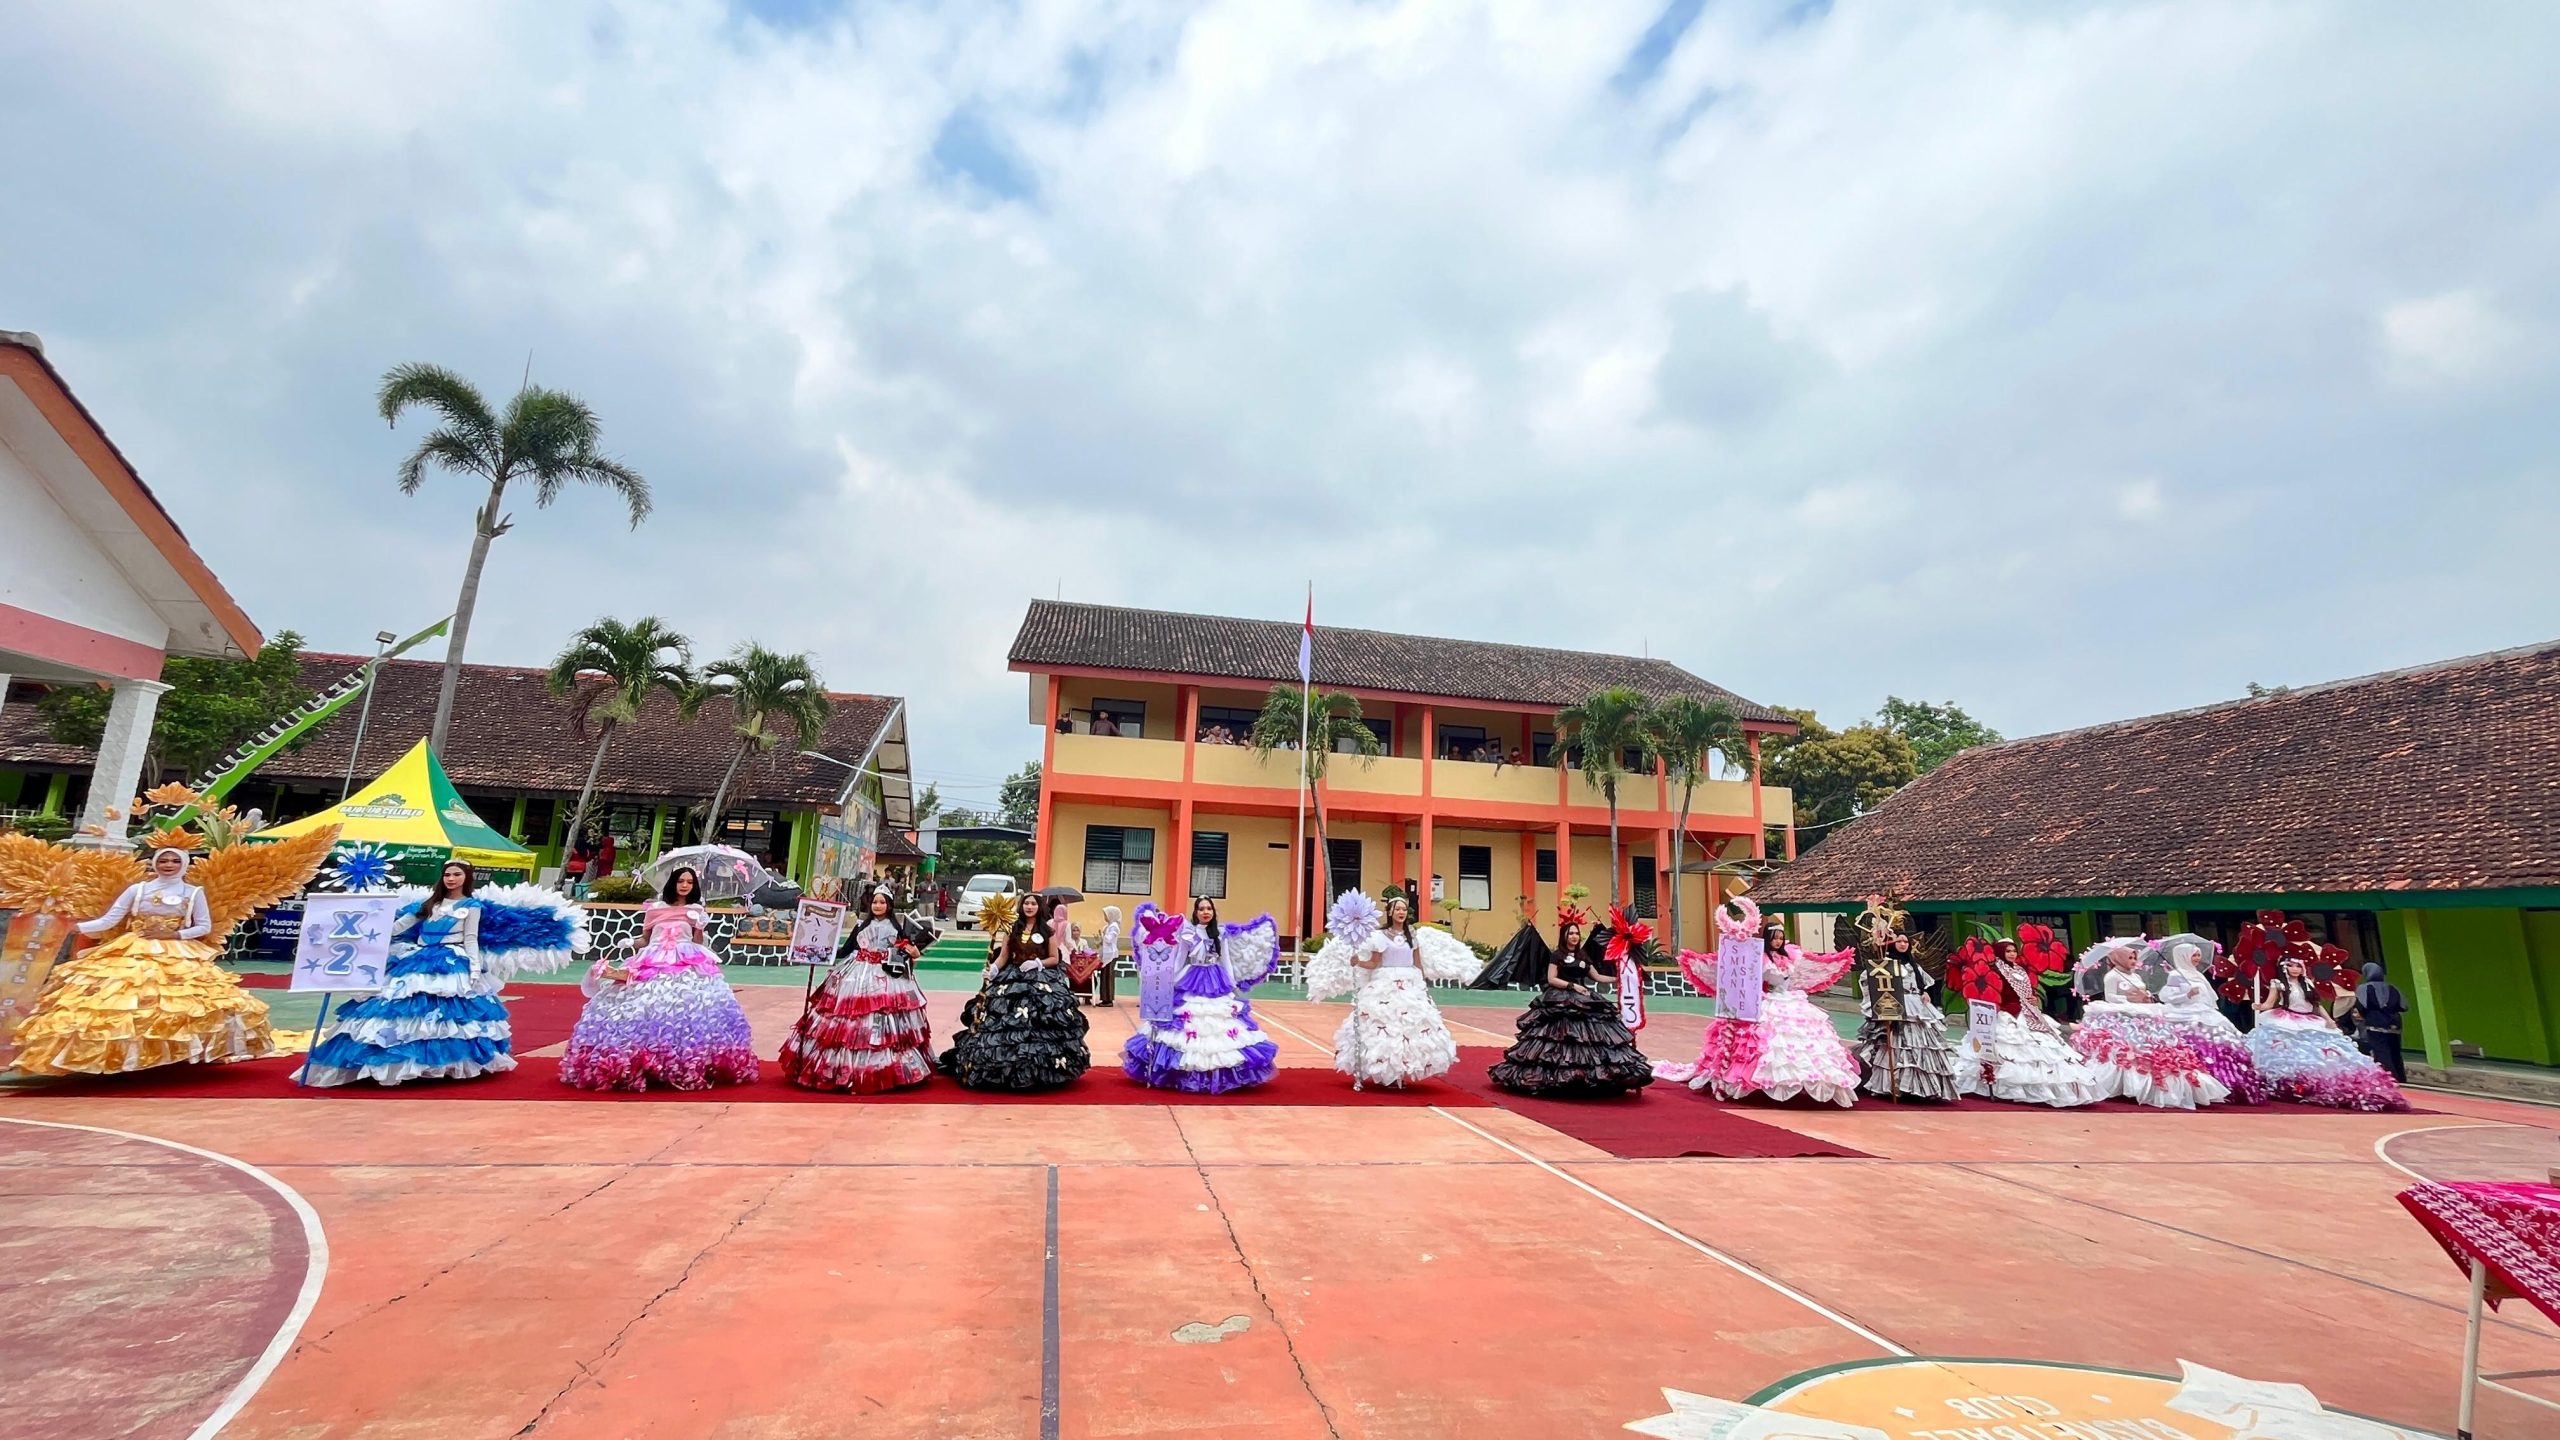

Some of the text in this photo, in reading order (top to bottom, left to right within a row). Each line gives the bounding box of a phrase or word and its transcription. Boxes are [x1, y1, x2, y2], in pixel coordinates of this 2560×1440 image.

[329, 911, 368, 938] X
[323, 942, 358, 975] 2
[1730, 945, 1739, 988] SMAN
[1944, 1394, 2060, 1420] CLUB
